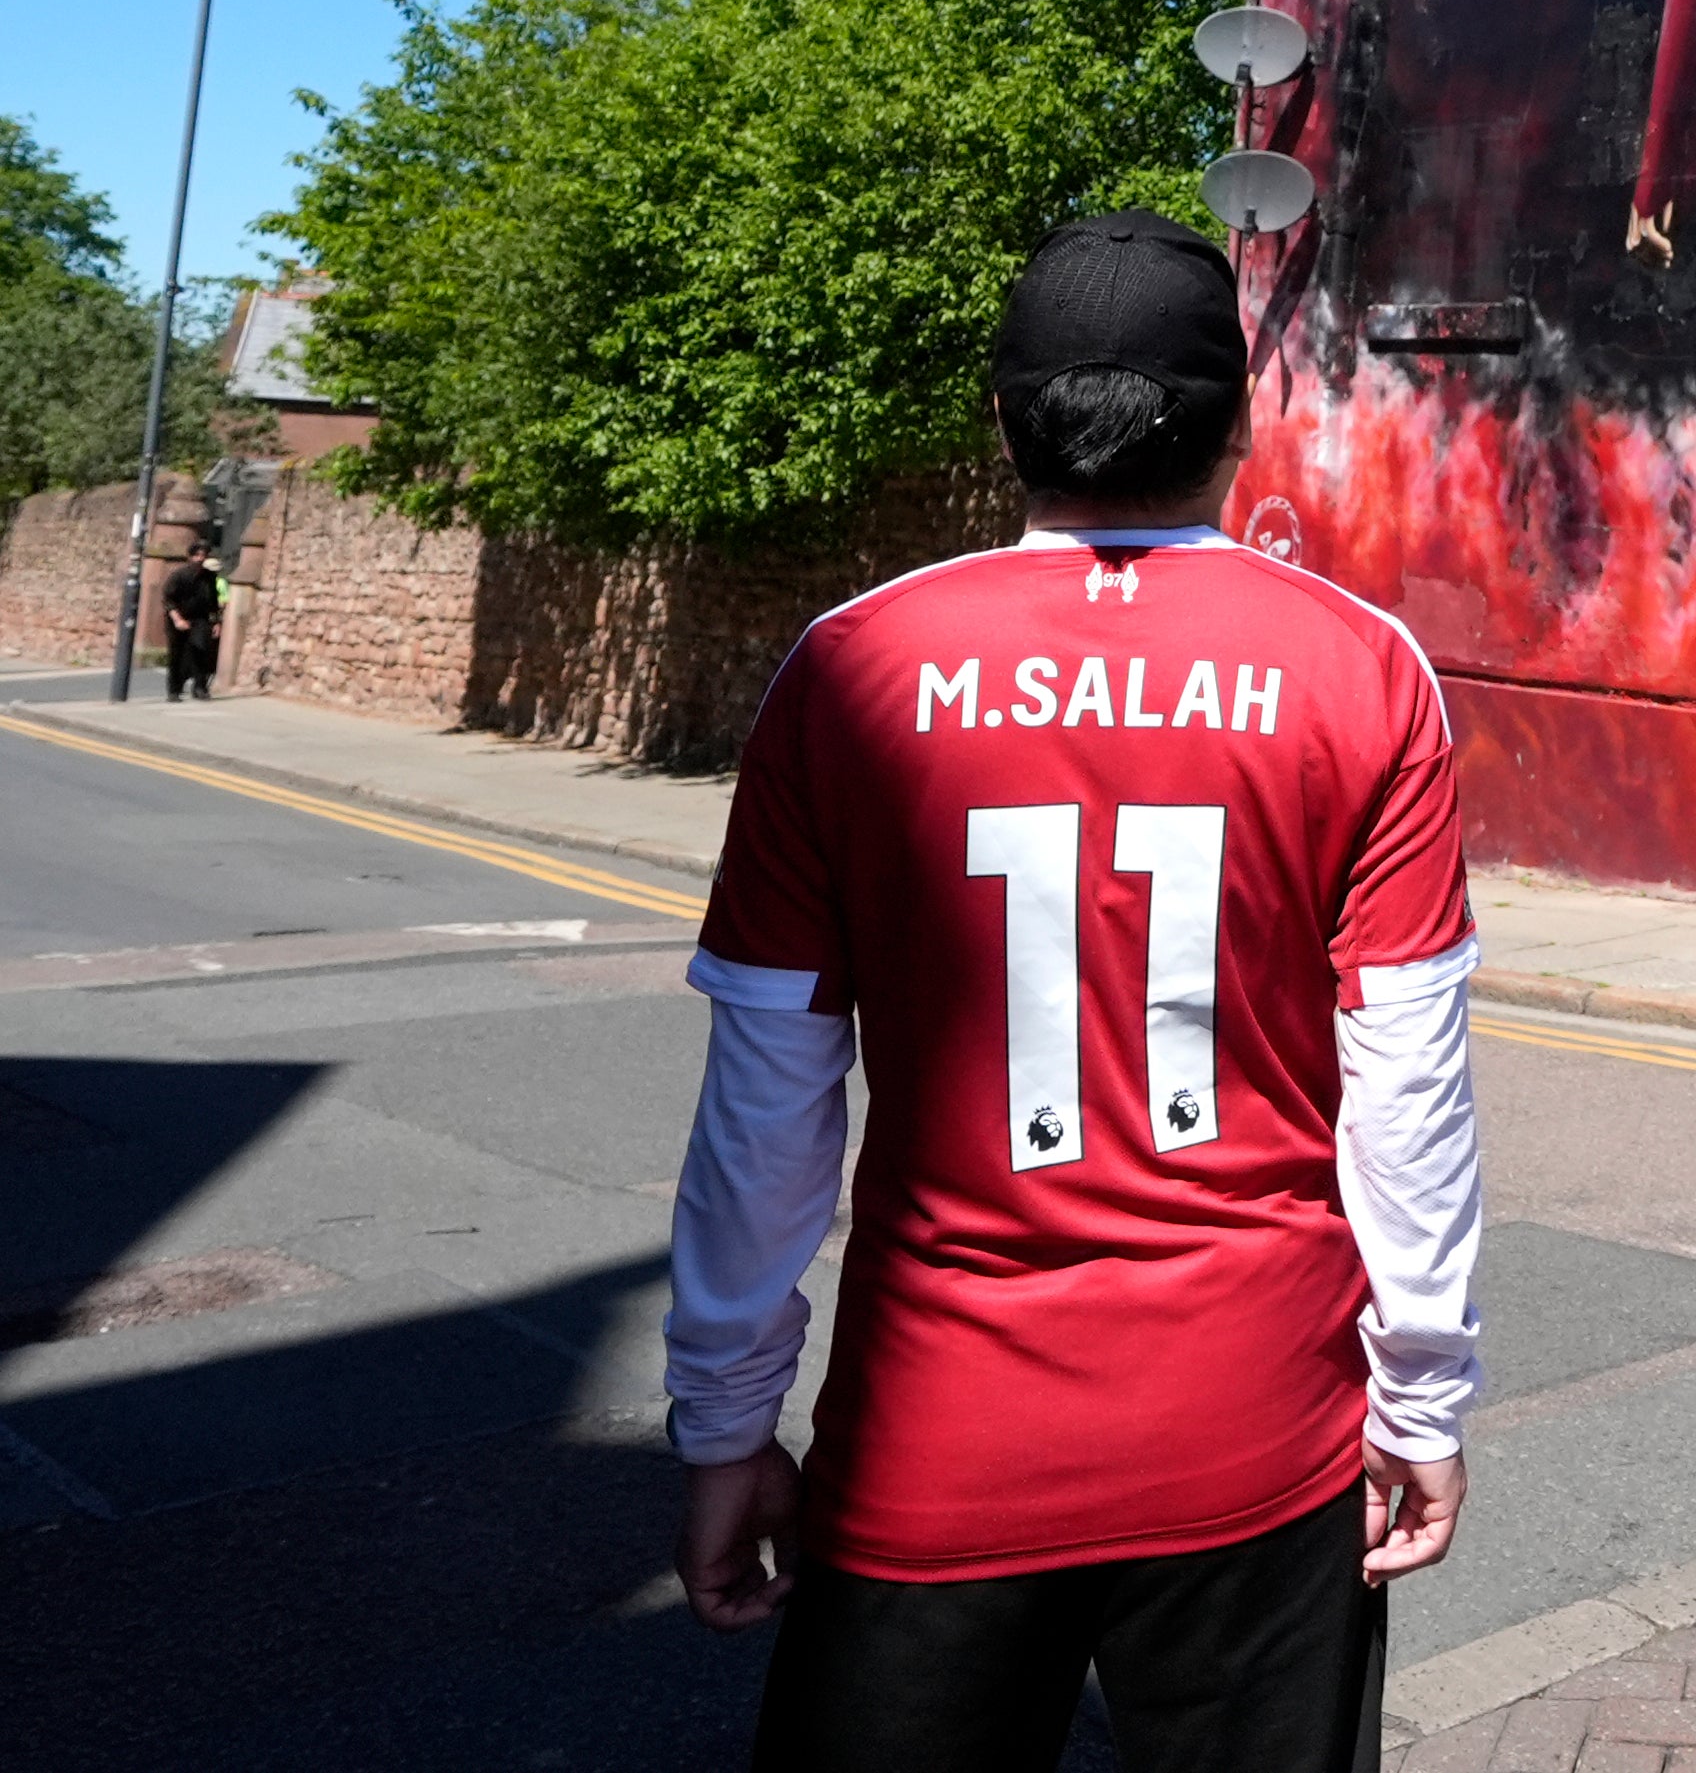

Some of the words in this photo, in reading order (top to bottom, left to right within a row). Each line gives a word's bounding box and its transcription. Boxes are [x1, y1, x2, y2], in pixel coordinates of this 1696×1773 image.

[1103, 572, 1123, 588] 97
[915, 656, 1284, 736] M.SALAH
[965, 803, 1227, 1173] 11
